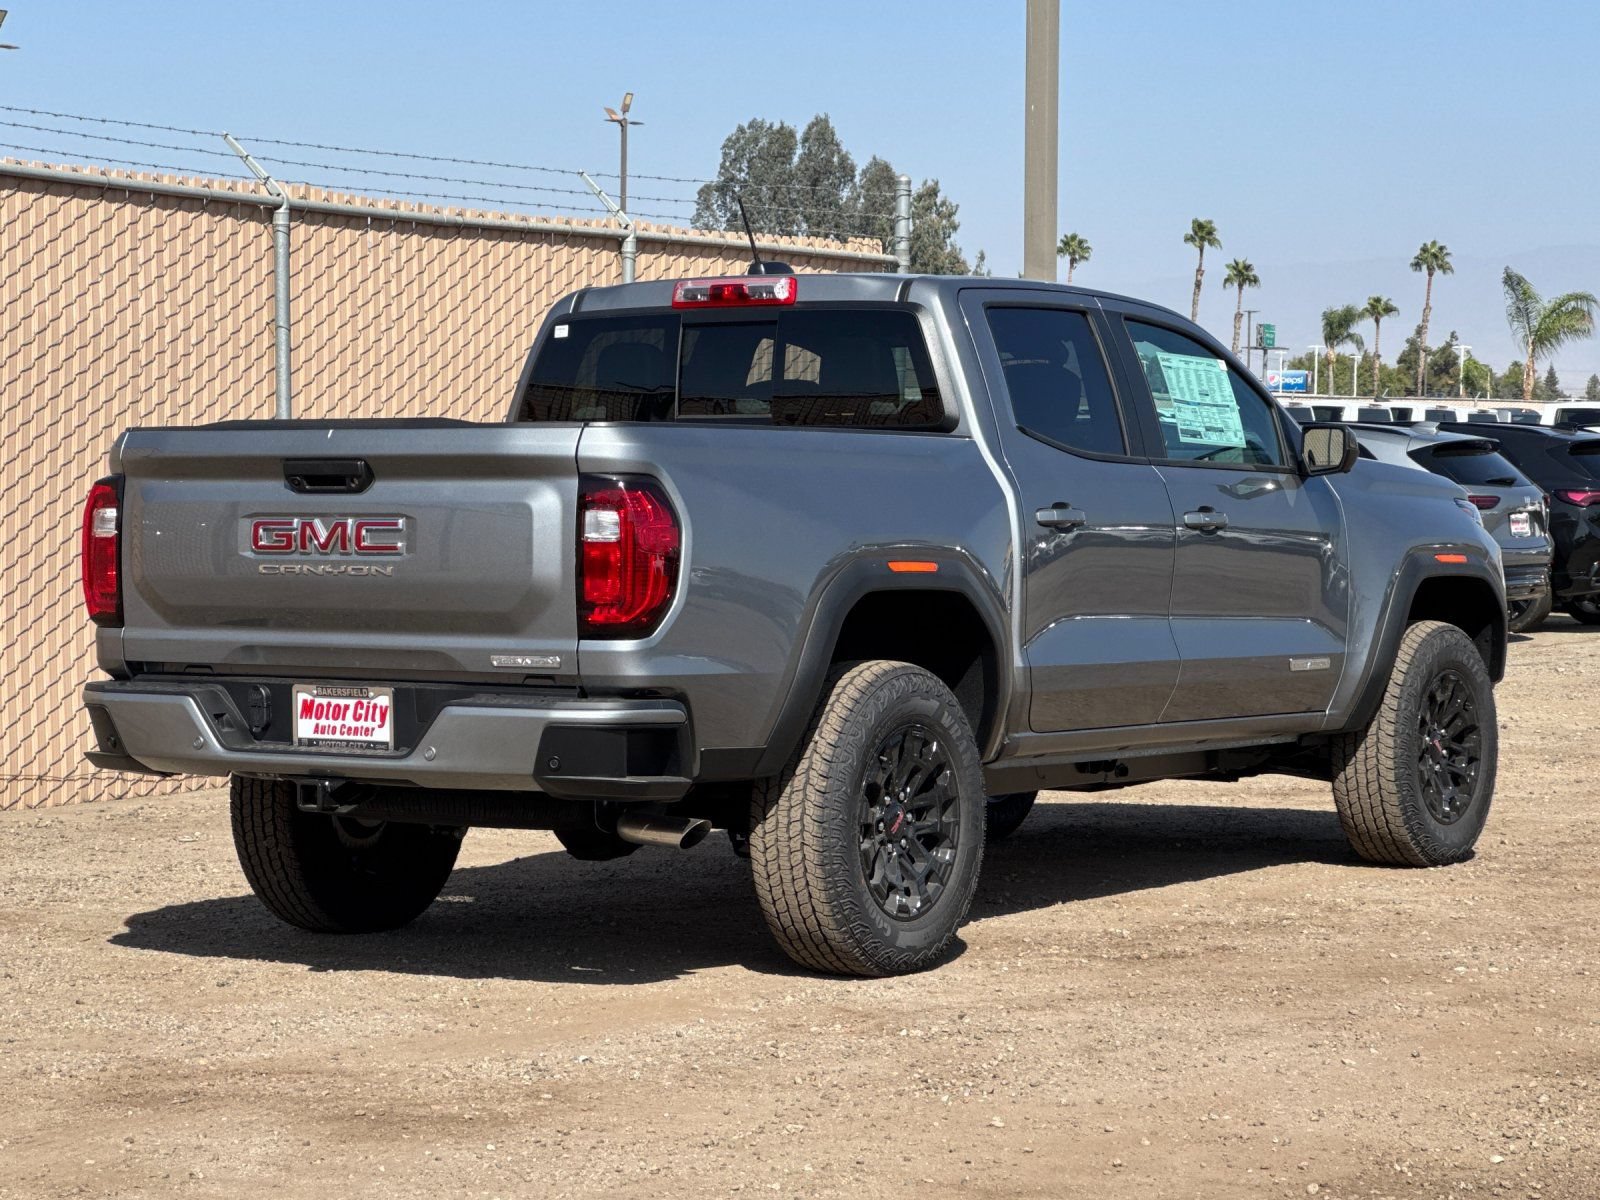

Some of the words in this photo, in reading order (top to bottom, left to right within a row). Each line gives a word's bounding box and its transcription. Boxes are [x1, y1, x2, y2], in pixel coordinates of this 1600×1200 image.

[251, 518, 405, 556] GMC
[258, 564, 393, 577] CANYON
[317, 688, 368, 697] BAKERSFIELD
[299, 698, 351, 721] Motor
[352, 700, 389, 729] City
[313, 723, 337, 736] Auto
[339, 724, 376, 738] Center
